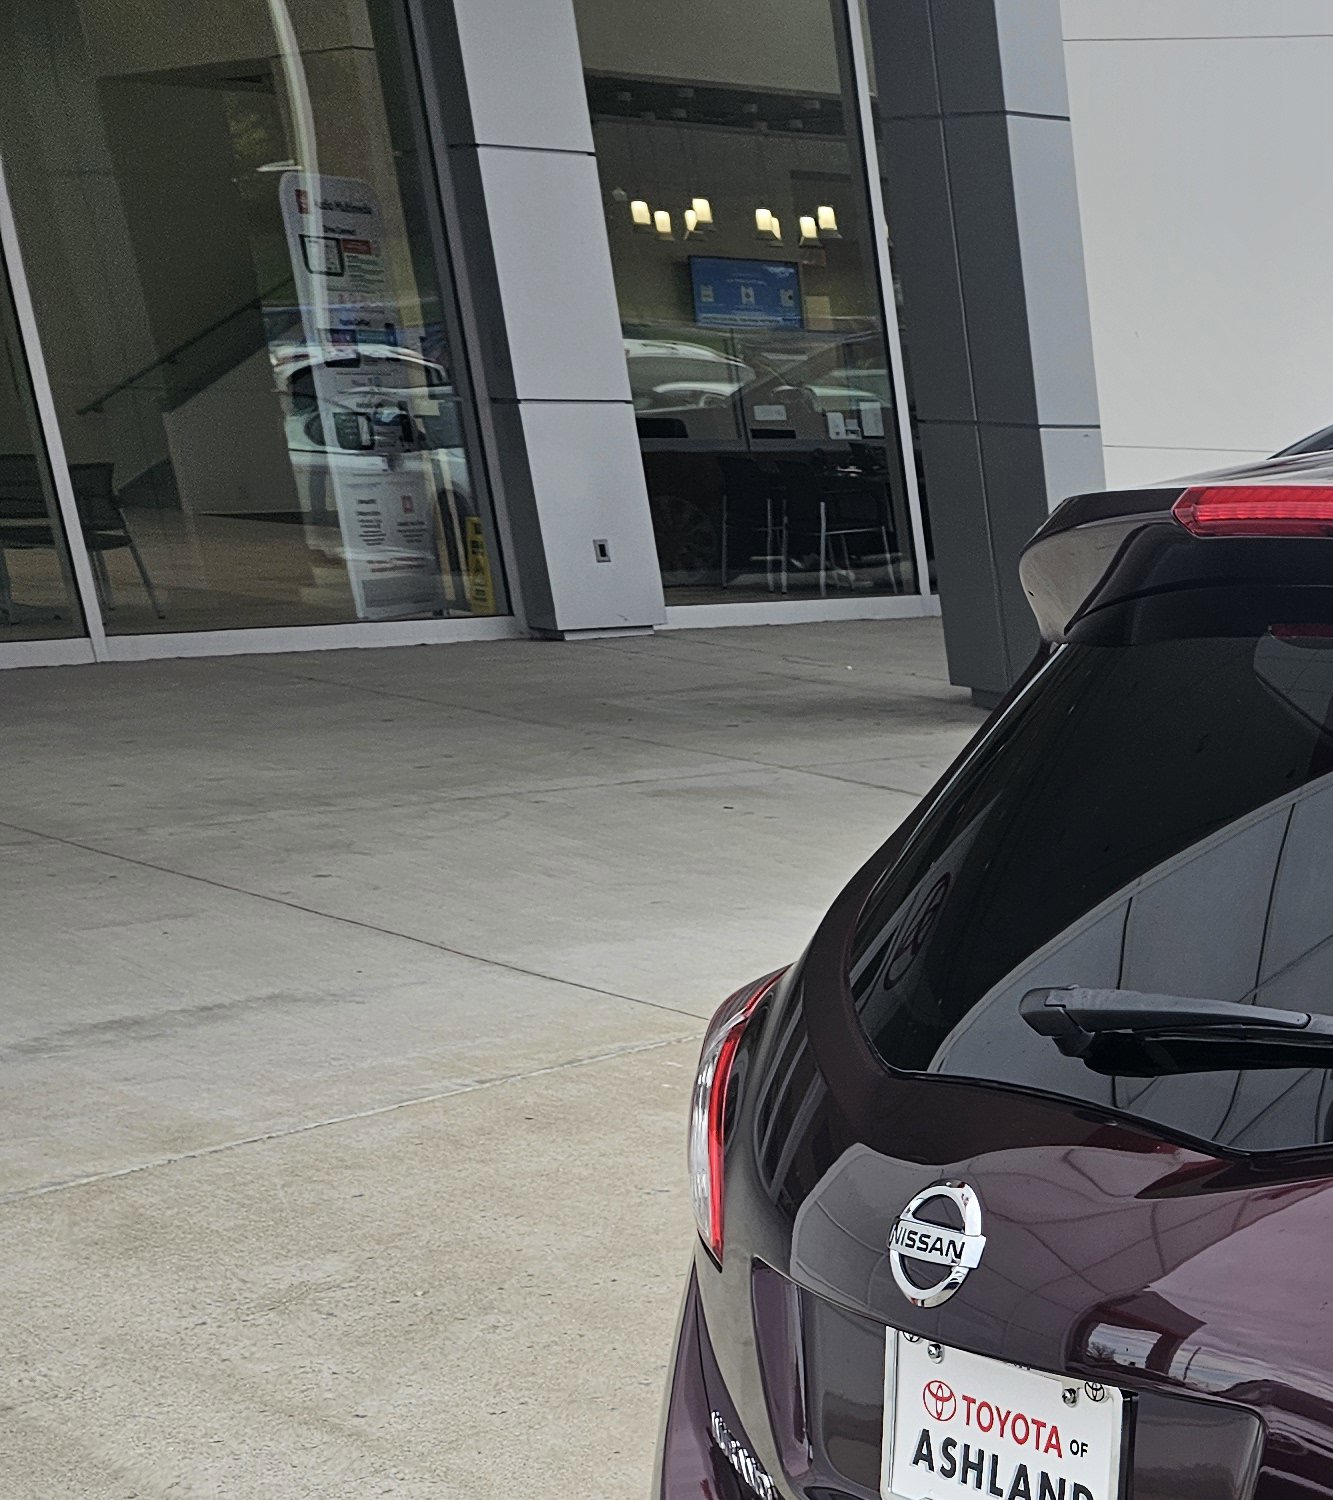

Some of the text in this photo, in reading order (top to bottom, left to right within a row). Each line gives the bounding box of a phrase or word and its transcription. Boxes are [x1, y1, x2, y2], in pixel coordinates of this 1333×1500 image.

[889, 1225, 966, 1259] NISSAN
[962, 1394, 1089, 1459] TOYOTA OF
